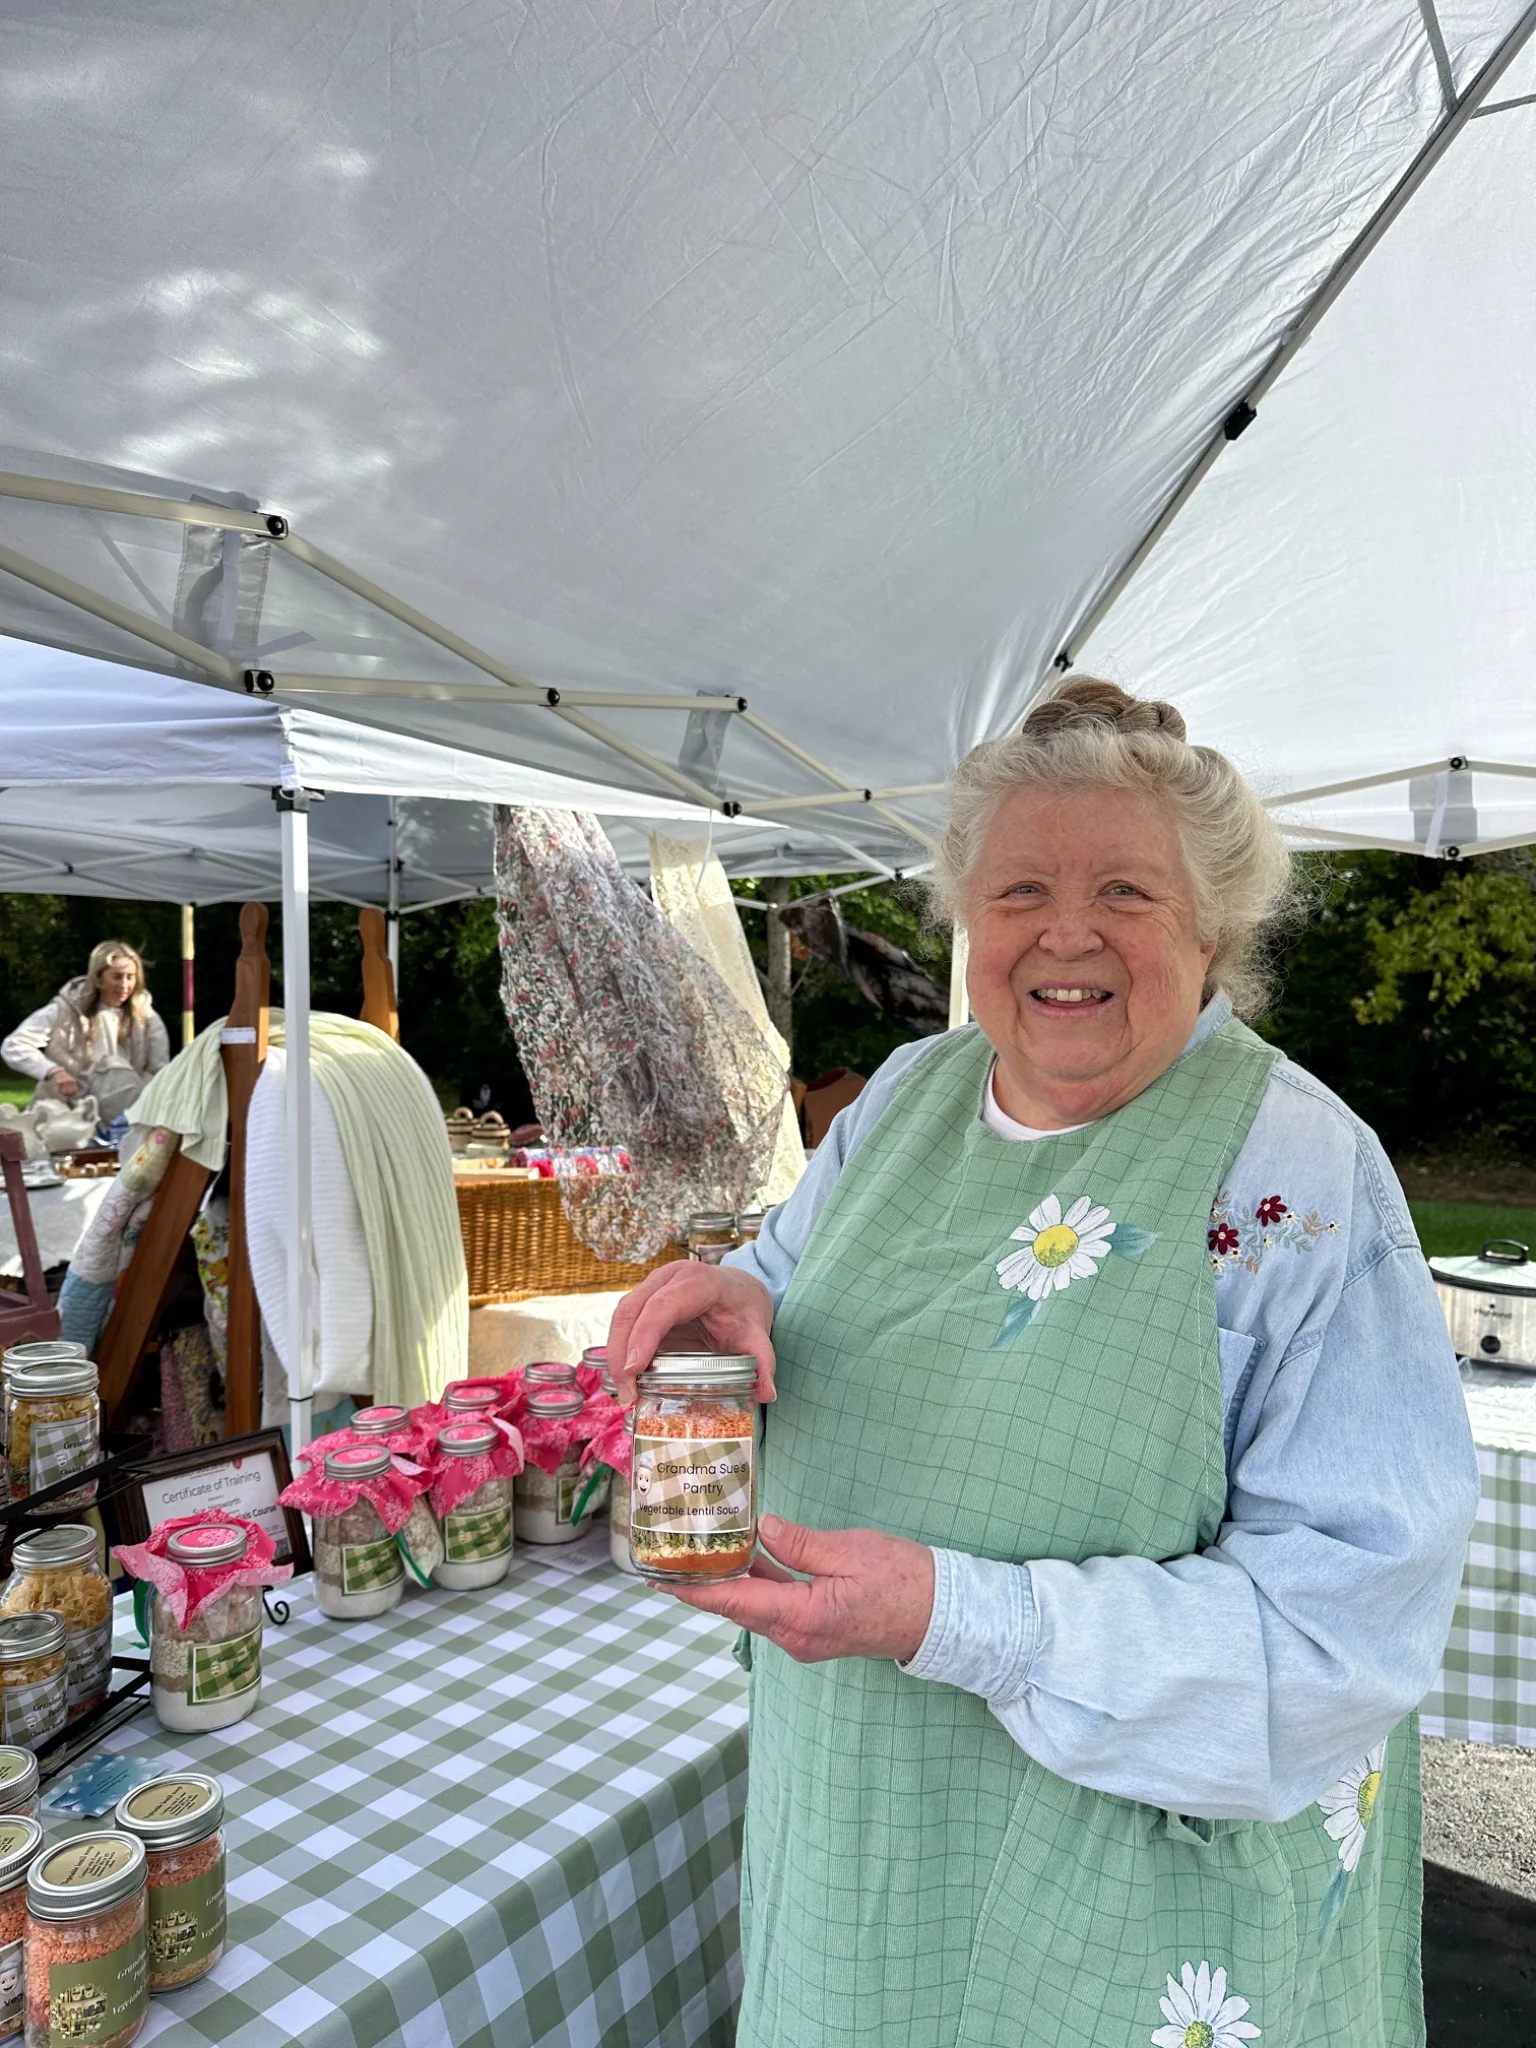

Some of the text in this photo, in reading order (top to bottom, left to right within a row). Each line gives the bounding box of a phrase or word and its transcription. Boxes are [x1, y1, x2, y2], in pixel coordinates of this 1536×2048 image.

[656, 1462, 747, 1475] Grandma Sue's
[162, 1484, 212, 1504] Certificate
[213, 1479, 224, 1491] of
[223, 1470, 262, 1487] Training
[683, 1482, 724, 1497] Pantry
[252, 1503, 277, 1518] Course
[639, 1502, 740, 1517] Vegetable Lentil Soup
